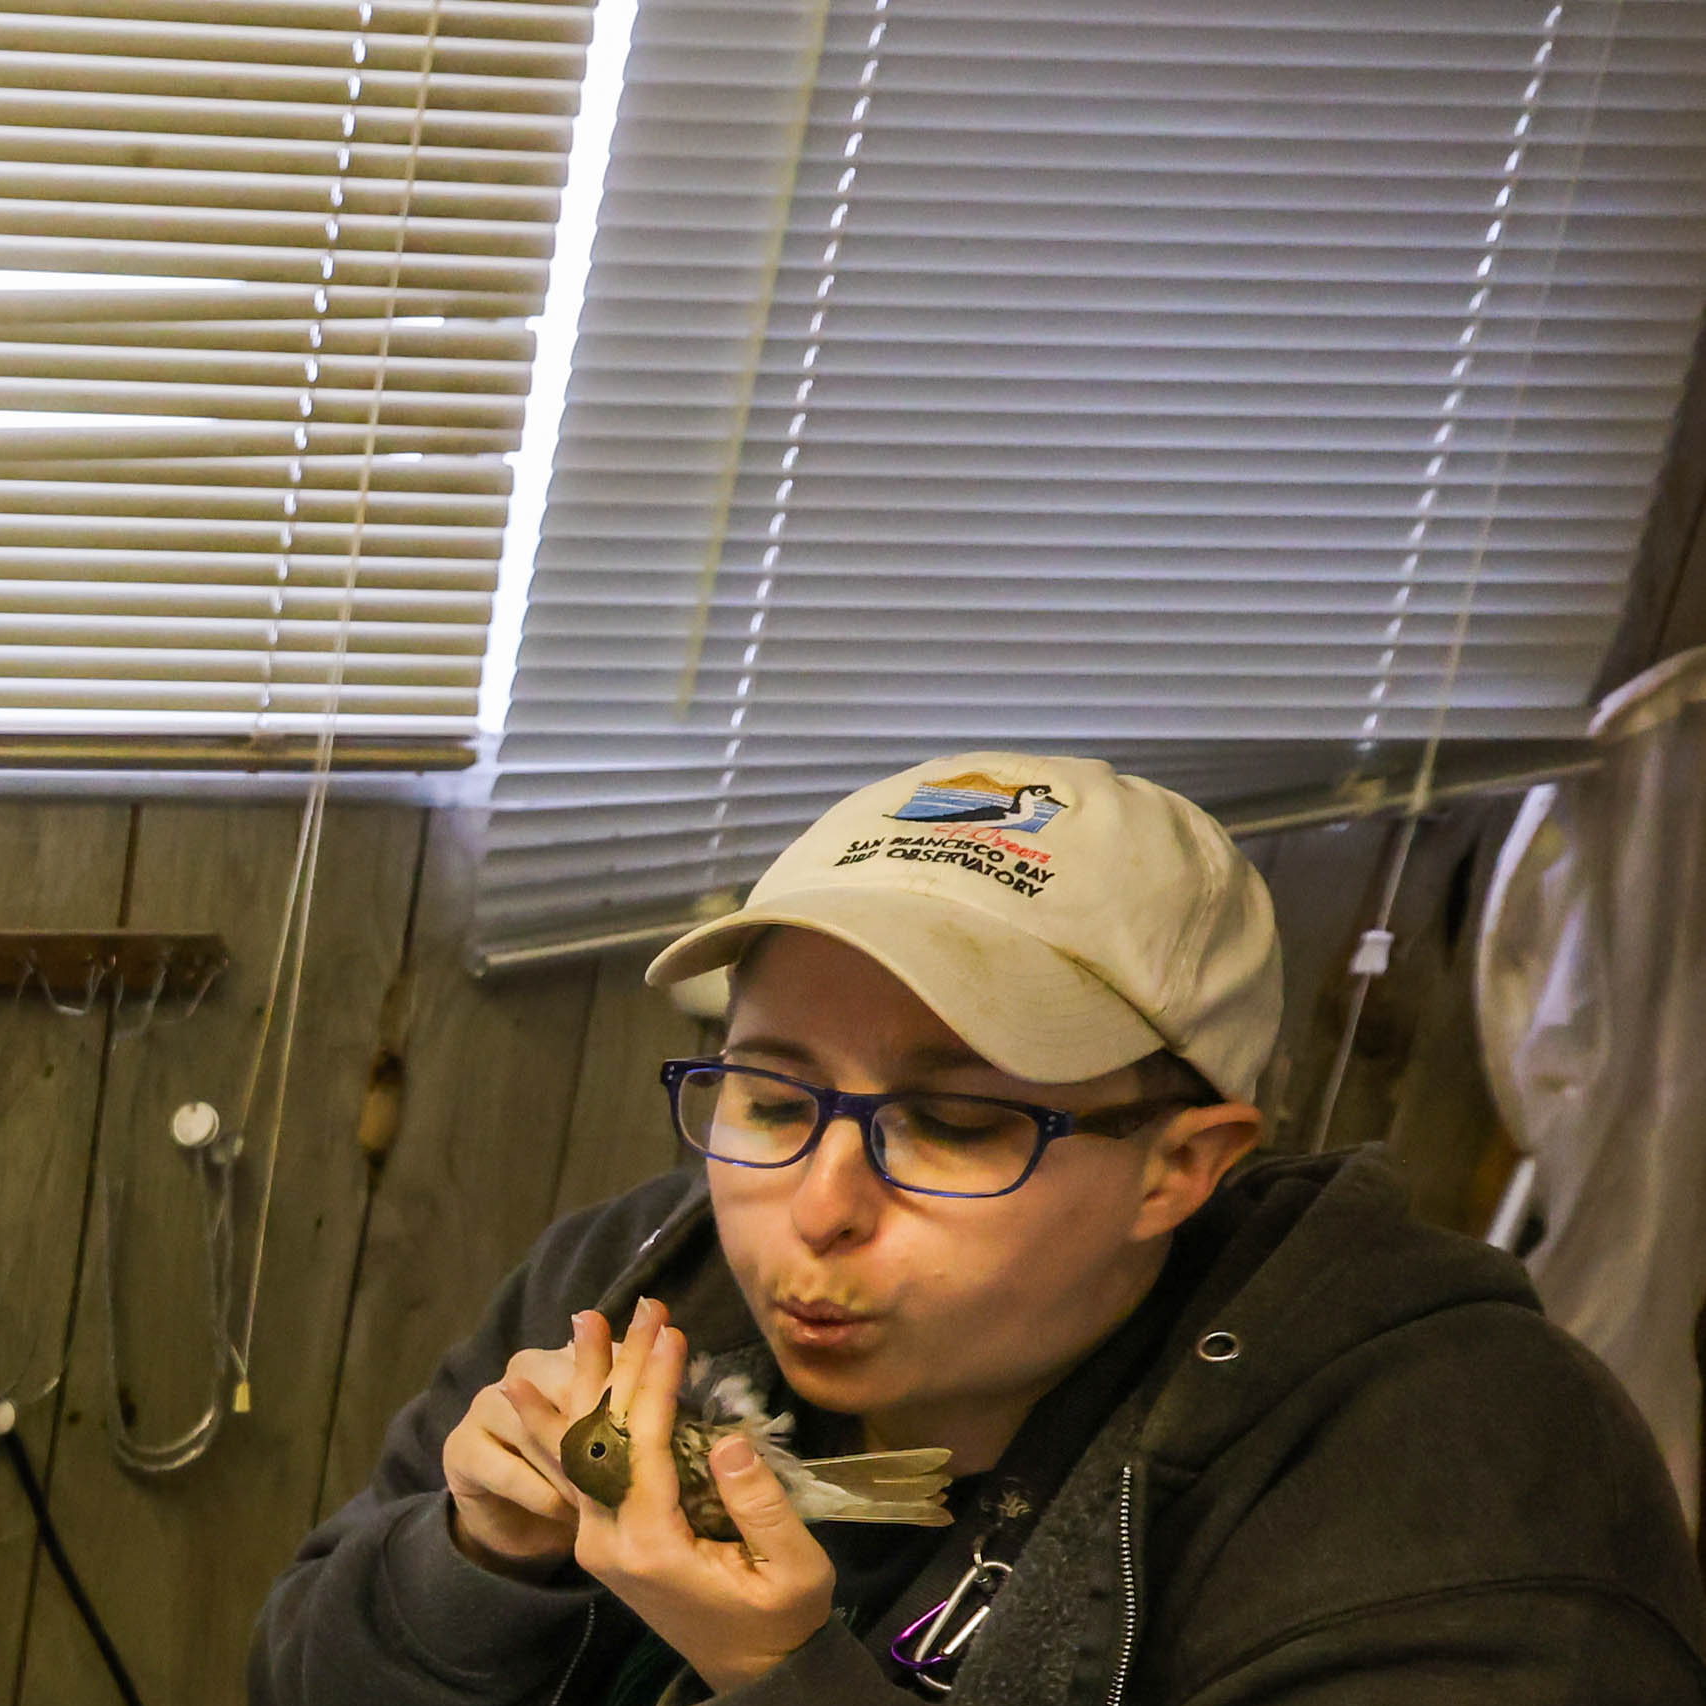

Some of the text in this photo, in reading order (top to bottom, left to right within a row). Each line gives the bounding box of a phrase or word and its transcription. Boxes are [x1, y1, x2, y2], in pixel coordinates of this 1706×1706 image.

[846, 836, 1055, 884] SAN FRANCISCO BAY
[886, 847, 1043, 898] OBSERVATORY
